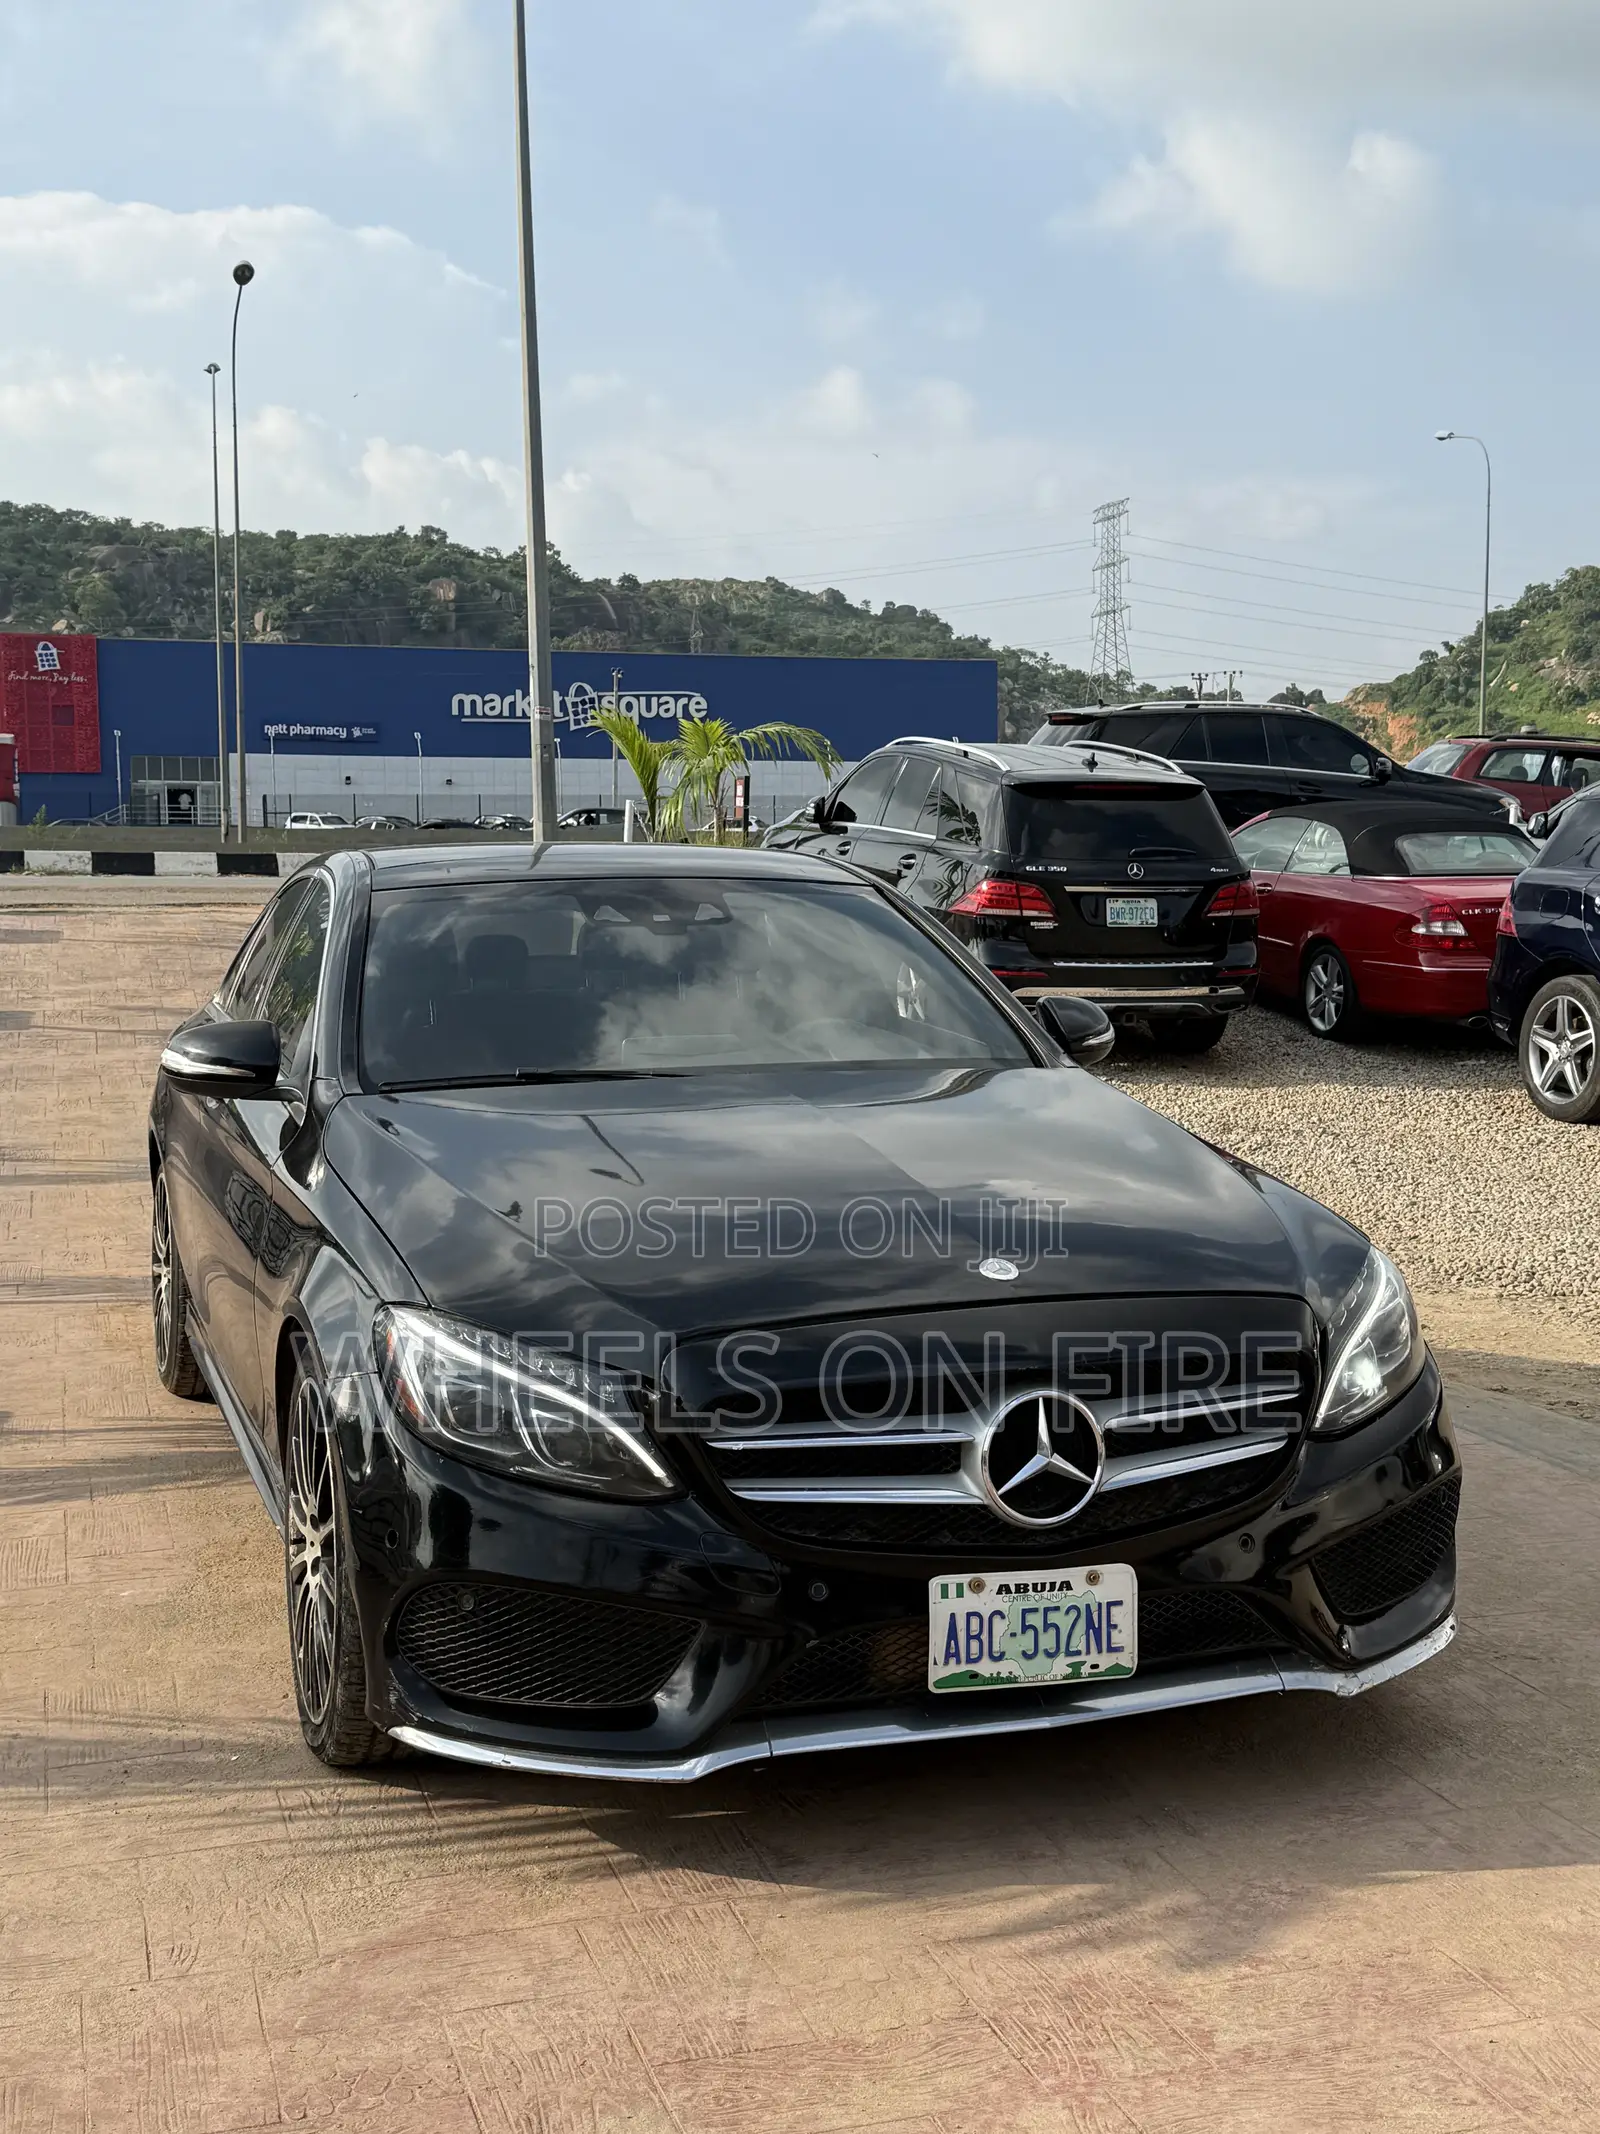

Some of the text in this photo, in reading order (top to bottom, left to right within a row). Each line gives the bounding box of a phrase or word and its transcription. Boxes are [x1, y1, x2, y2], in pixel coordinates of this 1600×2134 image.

[7, 670, 29, 681] Find
[30, 674, 52, 682] more,
[70, 671, 88, 682] less.
[451, 689, 708, 726] markt square
[264, 723, 288, 734] nett
[289, 723, 347, 739] pharmacy
[995, 1580, 1074, 1596] ABUJA
[1001, 1592, 1069, 1603] CENTRE OF UNITY
[943, 1600, 1125, 1666] ABC-552NE
